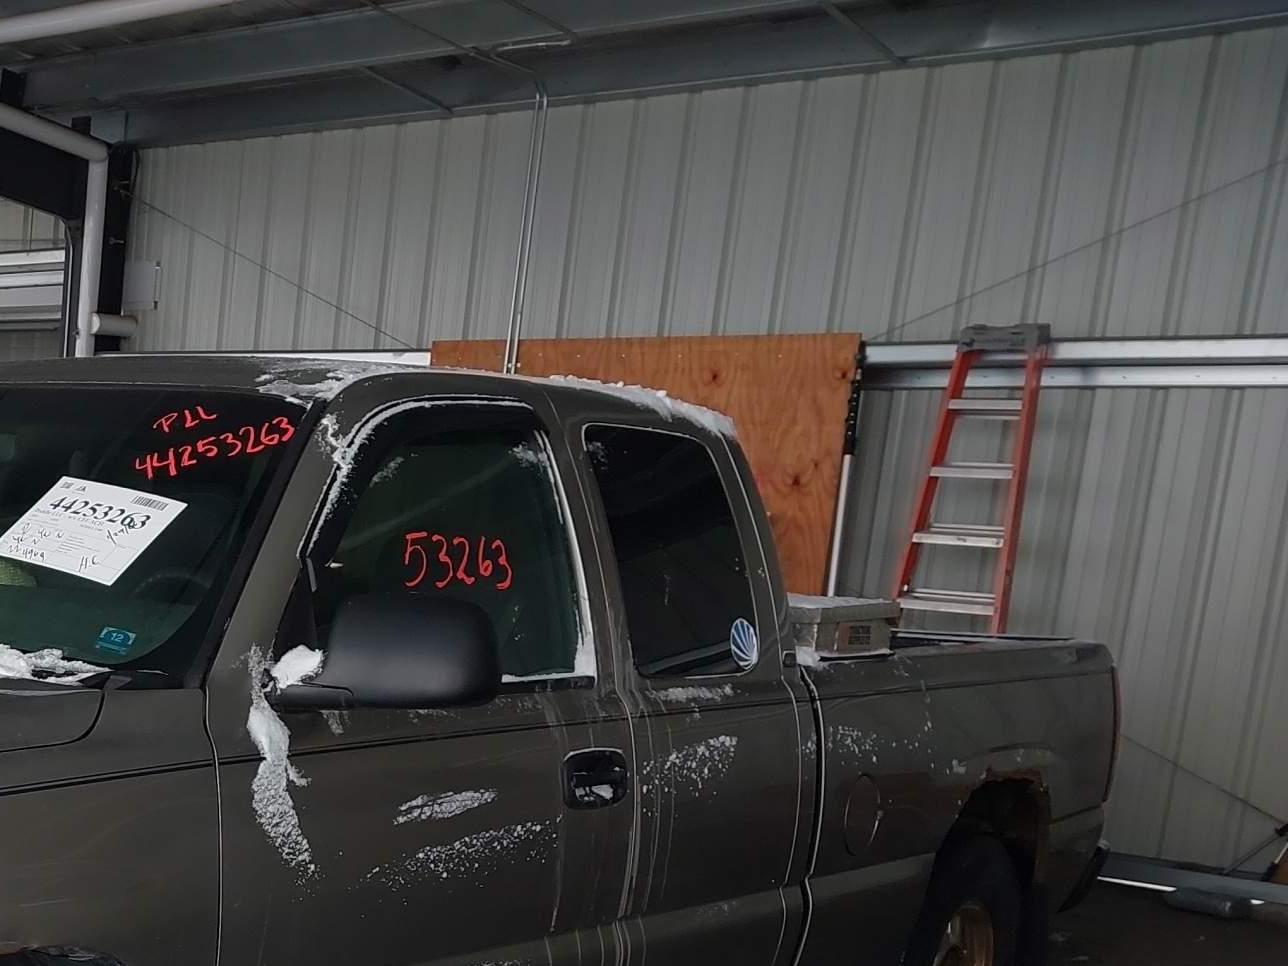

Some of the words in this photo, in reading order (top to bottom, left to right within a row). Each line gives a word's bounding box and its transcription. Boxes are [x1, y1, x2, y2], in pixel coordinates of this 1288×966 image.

[135, 416, 296, 480] 44253263
[49, 496, 152, 530] 44253263
[404, 531, 512, 590] 53263
[110, 632, 125, 643] 12
